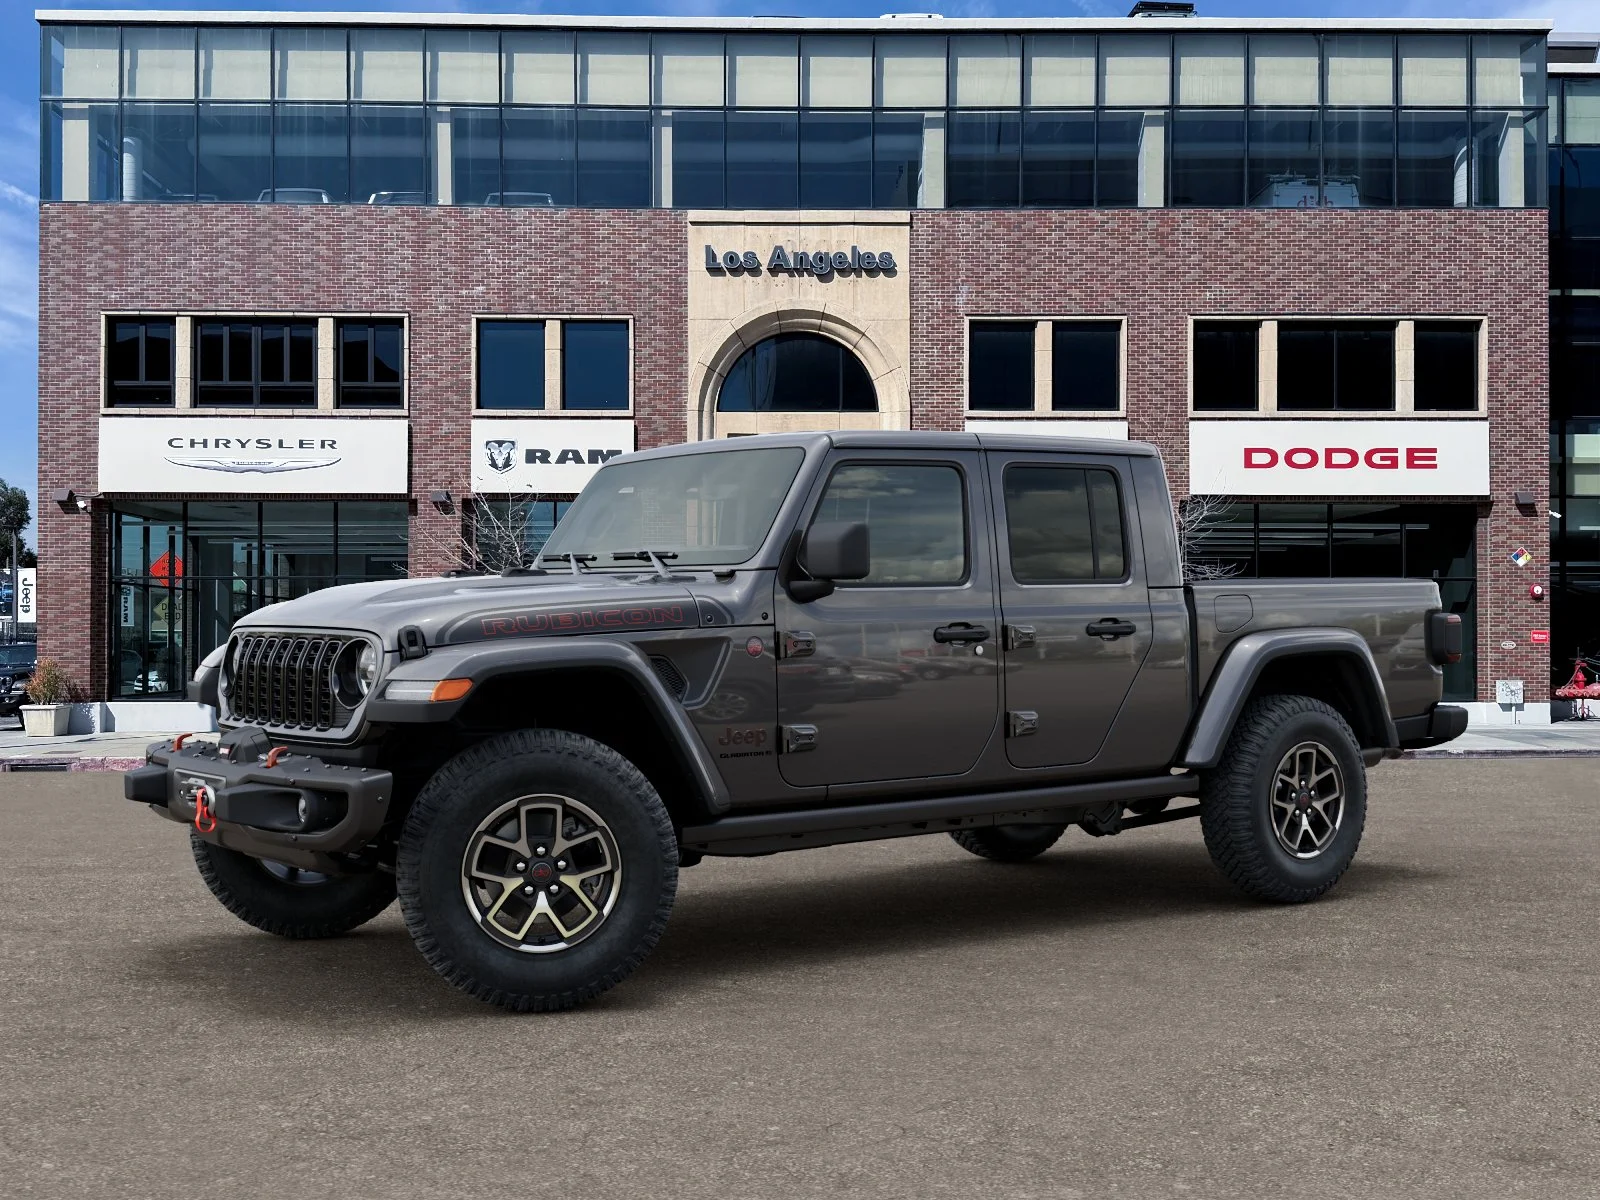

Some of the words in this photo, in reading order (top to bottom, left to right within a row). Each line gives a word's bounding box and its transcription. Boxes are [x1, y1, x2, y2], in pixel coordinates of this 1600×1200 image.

[704, 244, 758, 269] Los
[766, 245, 894, 275] Angeles
[167, 437, 338, 450] CHRYSLER
[525, 448, 623, 465] RAM
[1243, 447, 1438, 470] DODGE
[20, 577, 34, 613] Jeep
[161, 602, 182, 611] DAD
[480, 605, 684, 636] RUBICON
[718, 727, 767, 747] Jeep
